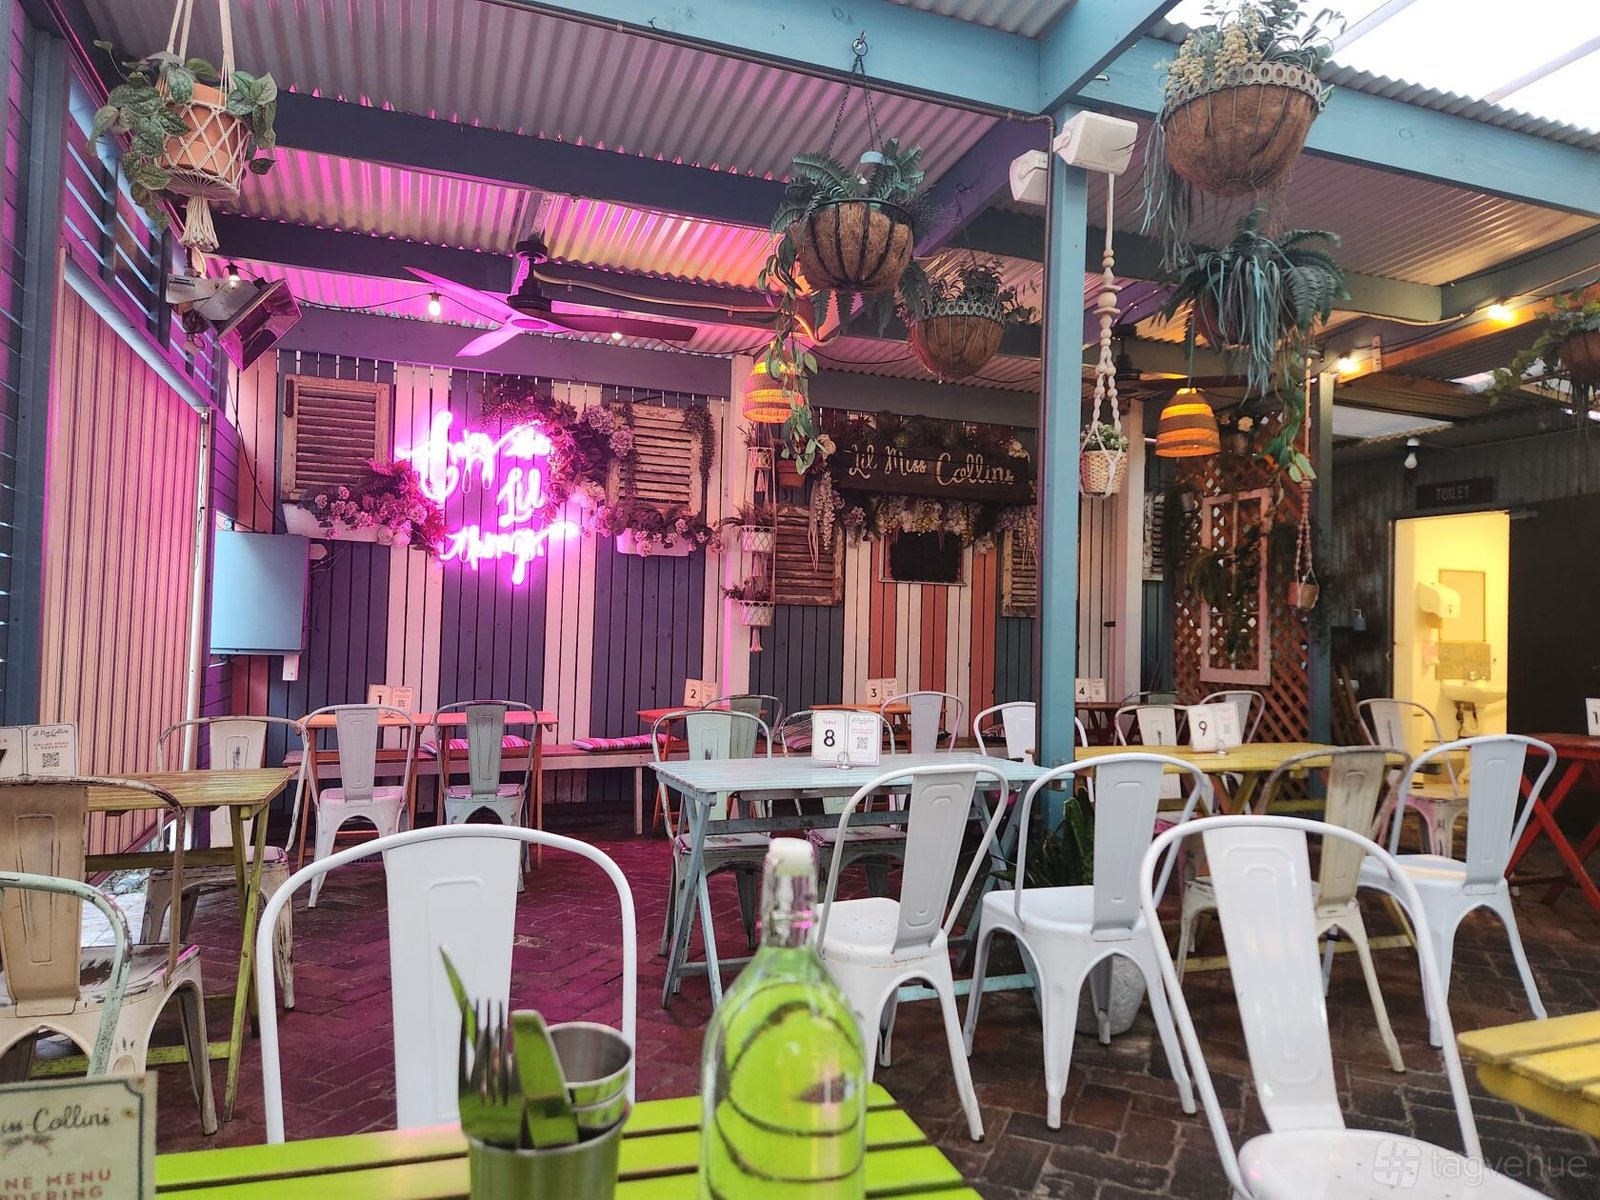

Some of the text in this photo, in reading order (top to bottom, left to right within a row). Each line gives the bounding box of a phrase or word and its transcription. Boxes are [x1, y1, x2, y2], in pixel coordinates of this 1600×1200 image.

[848, 444, 1015, 486] Lil Miss Collins
[1435, 485, 1471, 501] TOILET
[690, 688, 697, 699] 2
[870, 688, 877, 698] 3
[1078, 686, 1085, 696] 4
[377, 694, 383, 705] 1
[1198, 720, 1208, 737] 9
[823, 729, 836, 747] 8
[46, 1168, 110, 1186] MENU
